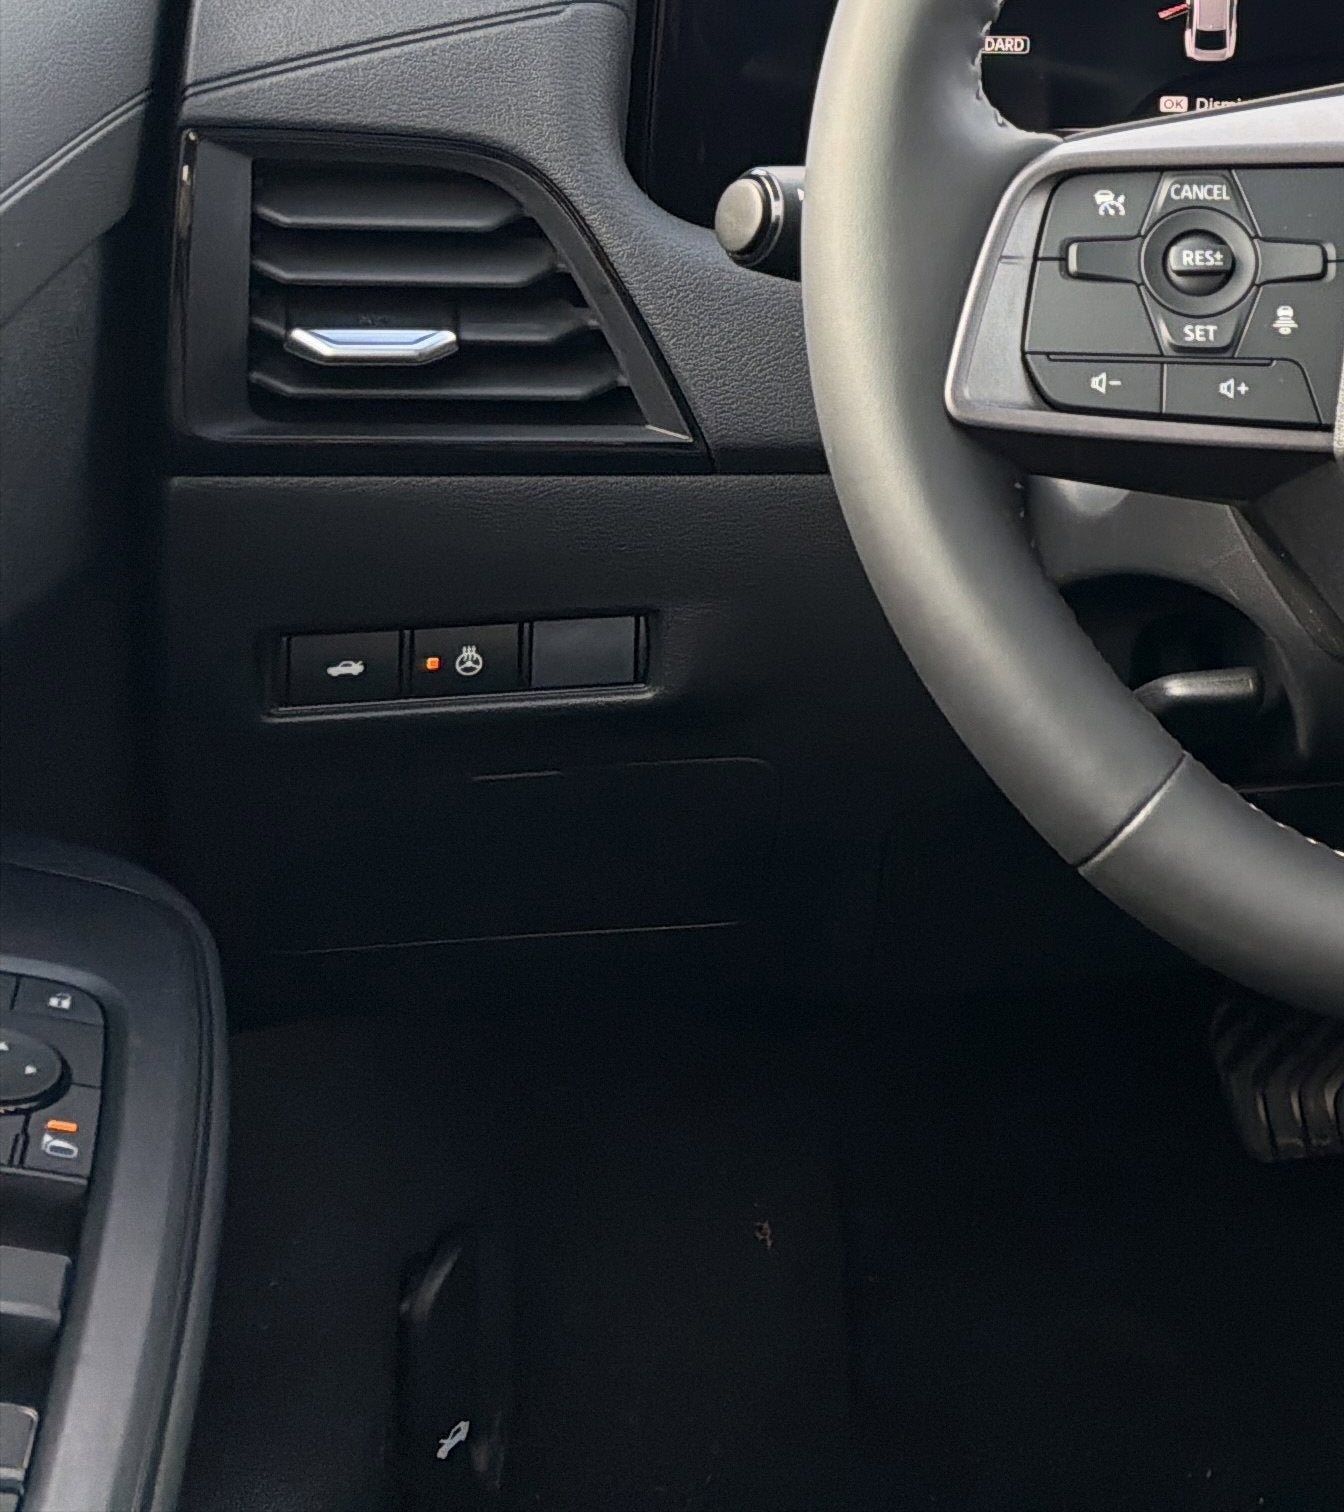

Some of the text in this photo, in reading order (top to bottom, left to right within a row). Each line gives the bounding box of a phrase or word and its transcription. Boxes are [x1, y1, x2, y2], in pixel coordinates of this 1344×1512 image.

[984, 38, 1025, 52] DARD
[1164, 99, 1183, 109] OK
[1170, 184, 1231, 201] CANCEL
[1183, 324, 1218, 342] SET
